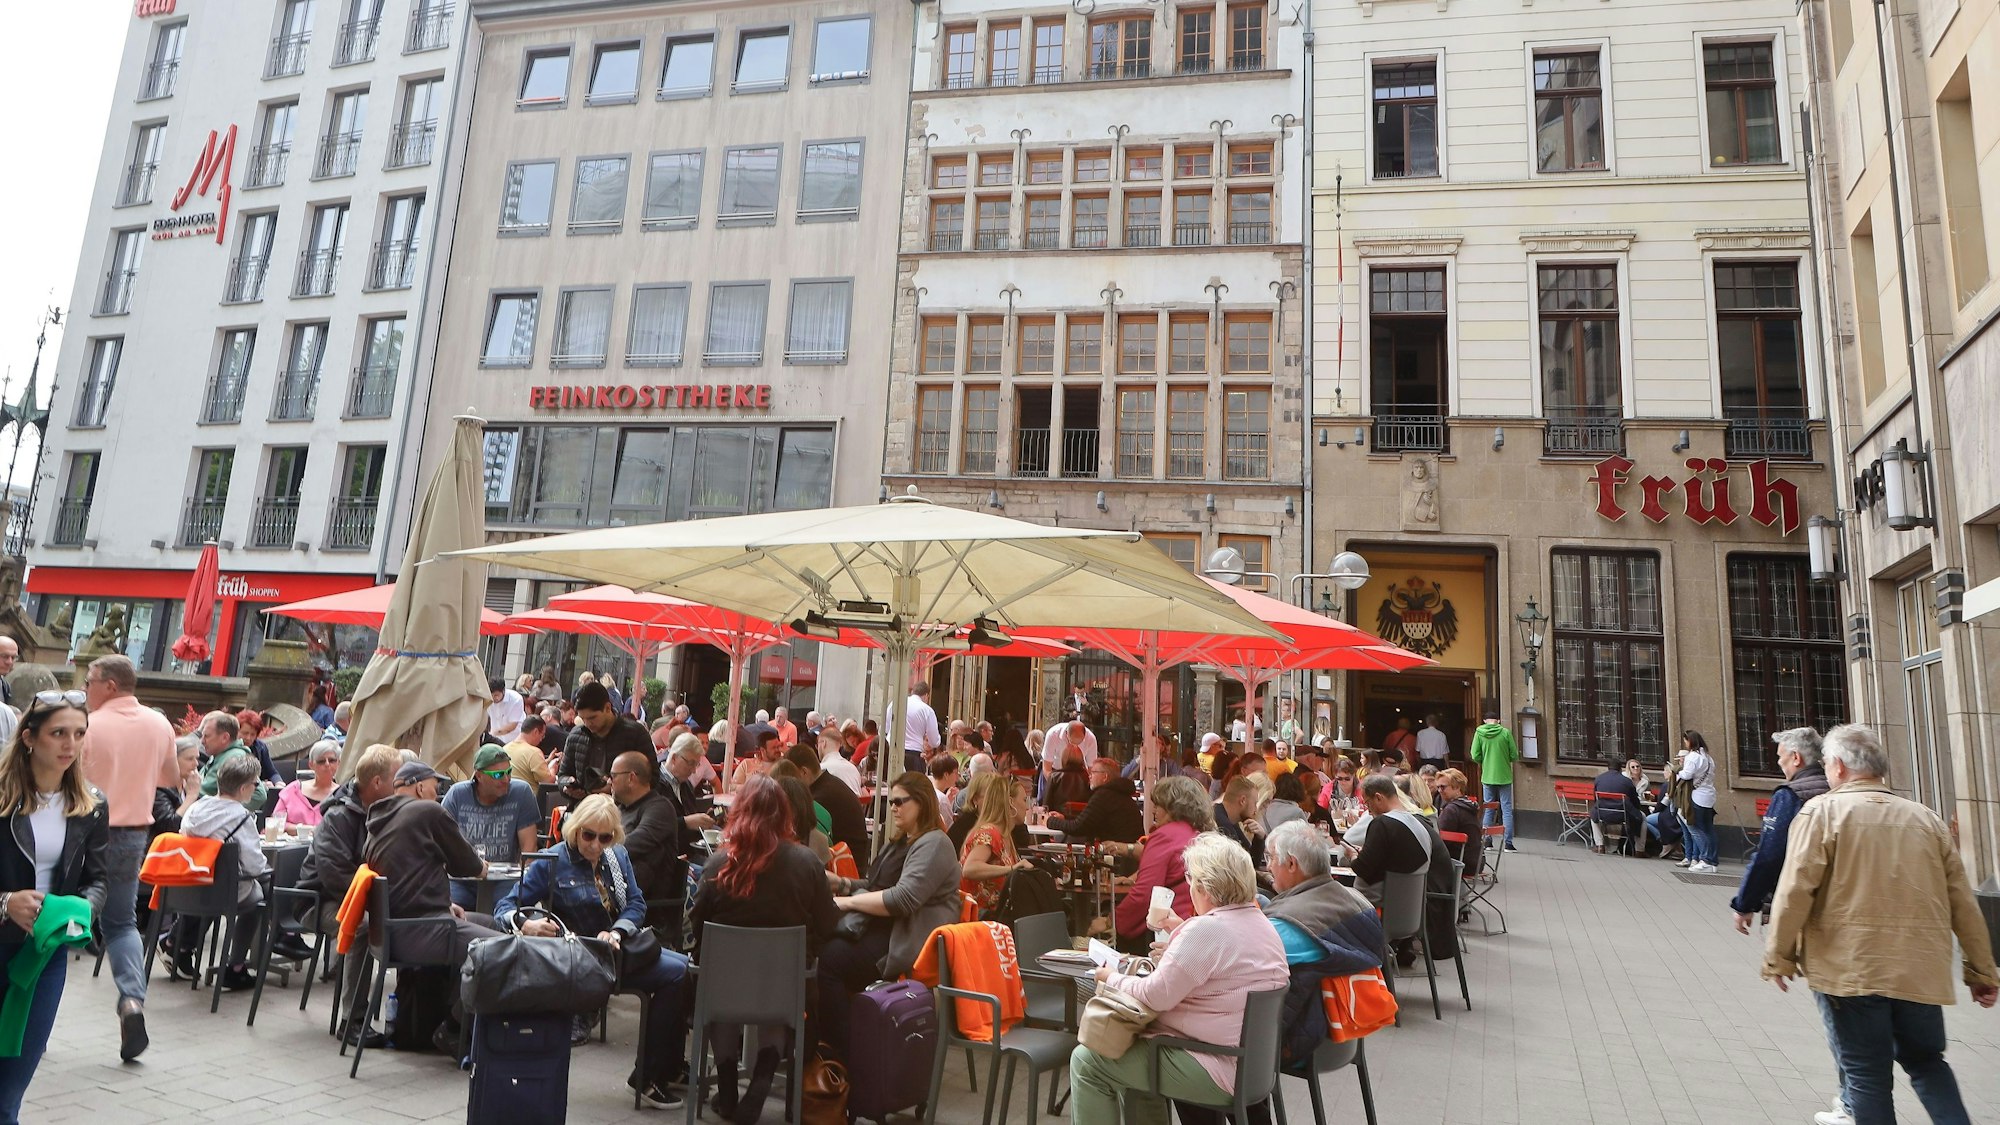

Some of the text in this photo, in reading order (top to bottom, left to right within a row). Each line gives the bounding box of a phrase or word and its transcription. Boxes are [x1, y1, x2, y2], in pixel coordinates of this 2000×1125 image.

[529, 384, 772, 409] FEINKOSTTHEKE
[1586, 454, 1801, 538] früh
[217, 574, 280, 600] früh SHOPPEN
[486, 821, 509, 838] LIFE
